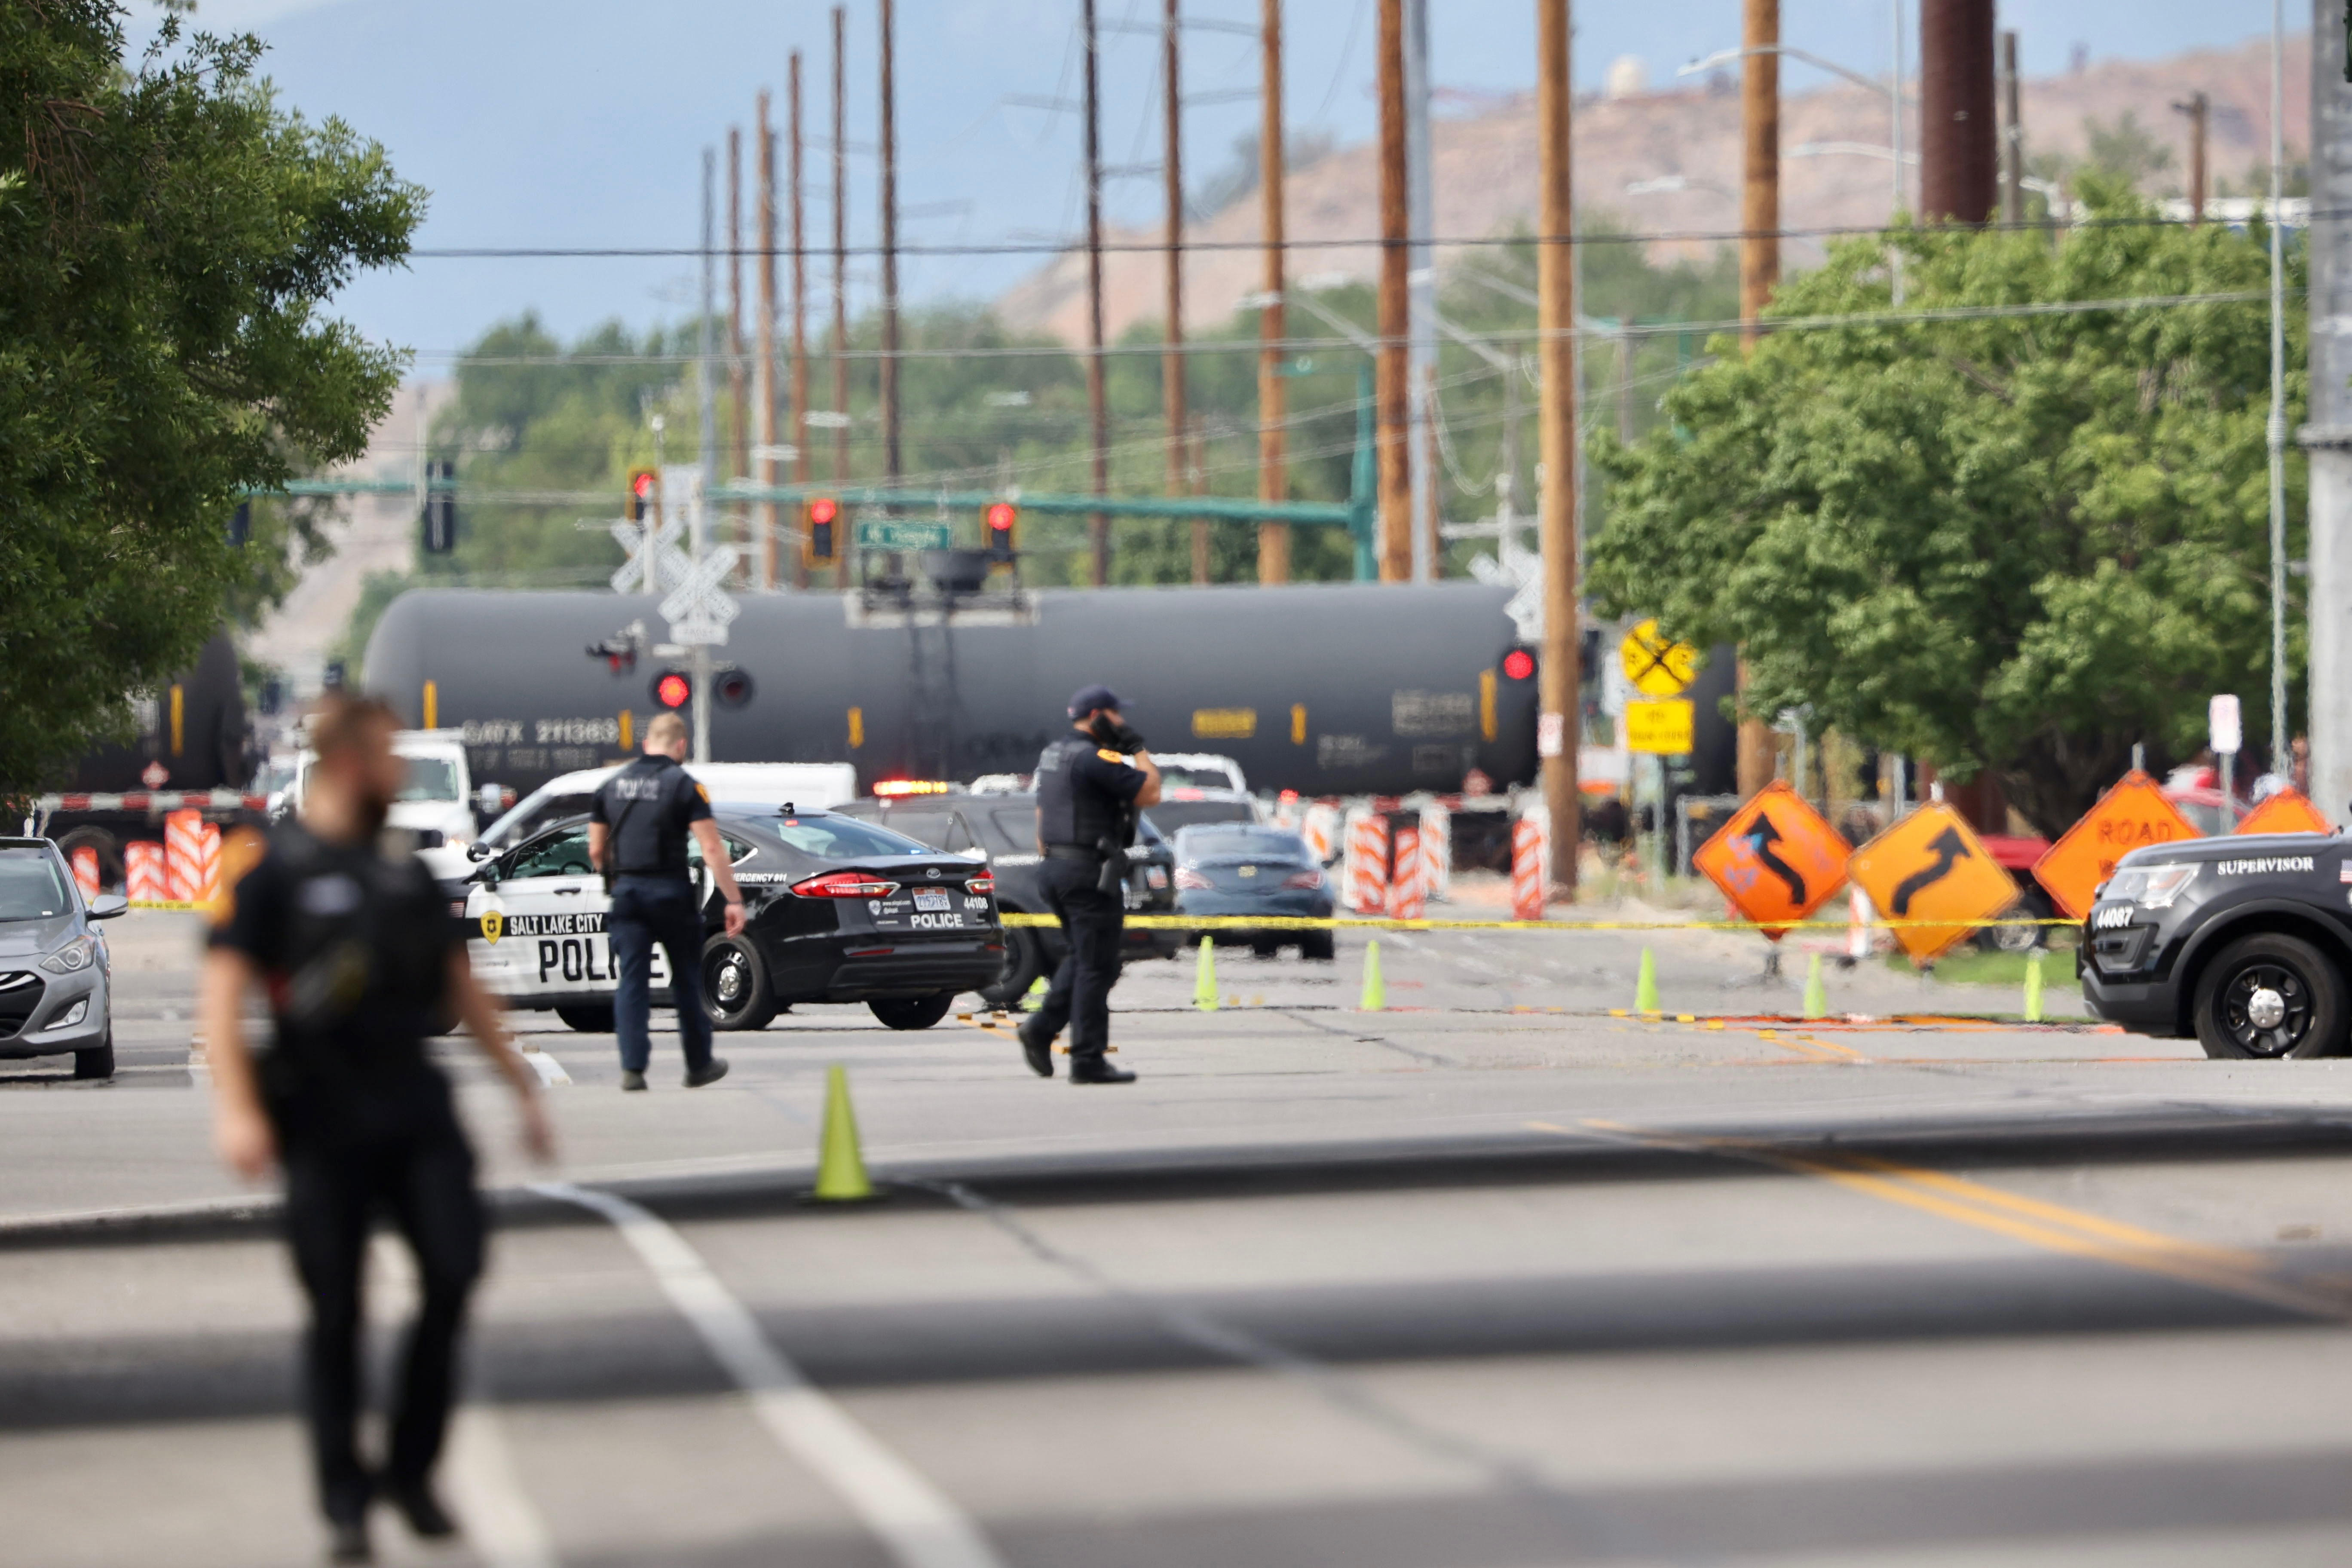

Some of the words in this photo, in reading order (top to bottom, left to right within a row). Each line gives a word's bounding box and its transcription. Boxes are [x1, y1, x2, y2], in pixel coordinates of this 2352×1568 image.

[2098, 819, 2173, 845] ROAD
[2217, 857, 2314, 875] SUPERVISOR
[732, 873, 774, 882] MERGENCY
[964, 897, 988, 909] 44108
[510, 916, 538, 935] SALT
[542, 915, 573, 934] LAKE
[576, 913, 603, 932] CITY
[910, 913, 964, 928] POLICE
[2097, 906, 2134, 928] 44087
[539, 938, 665, 983] POLIE
